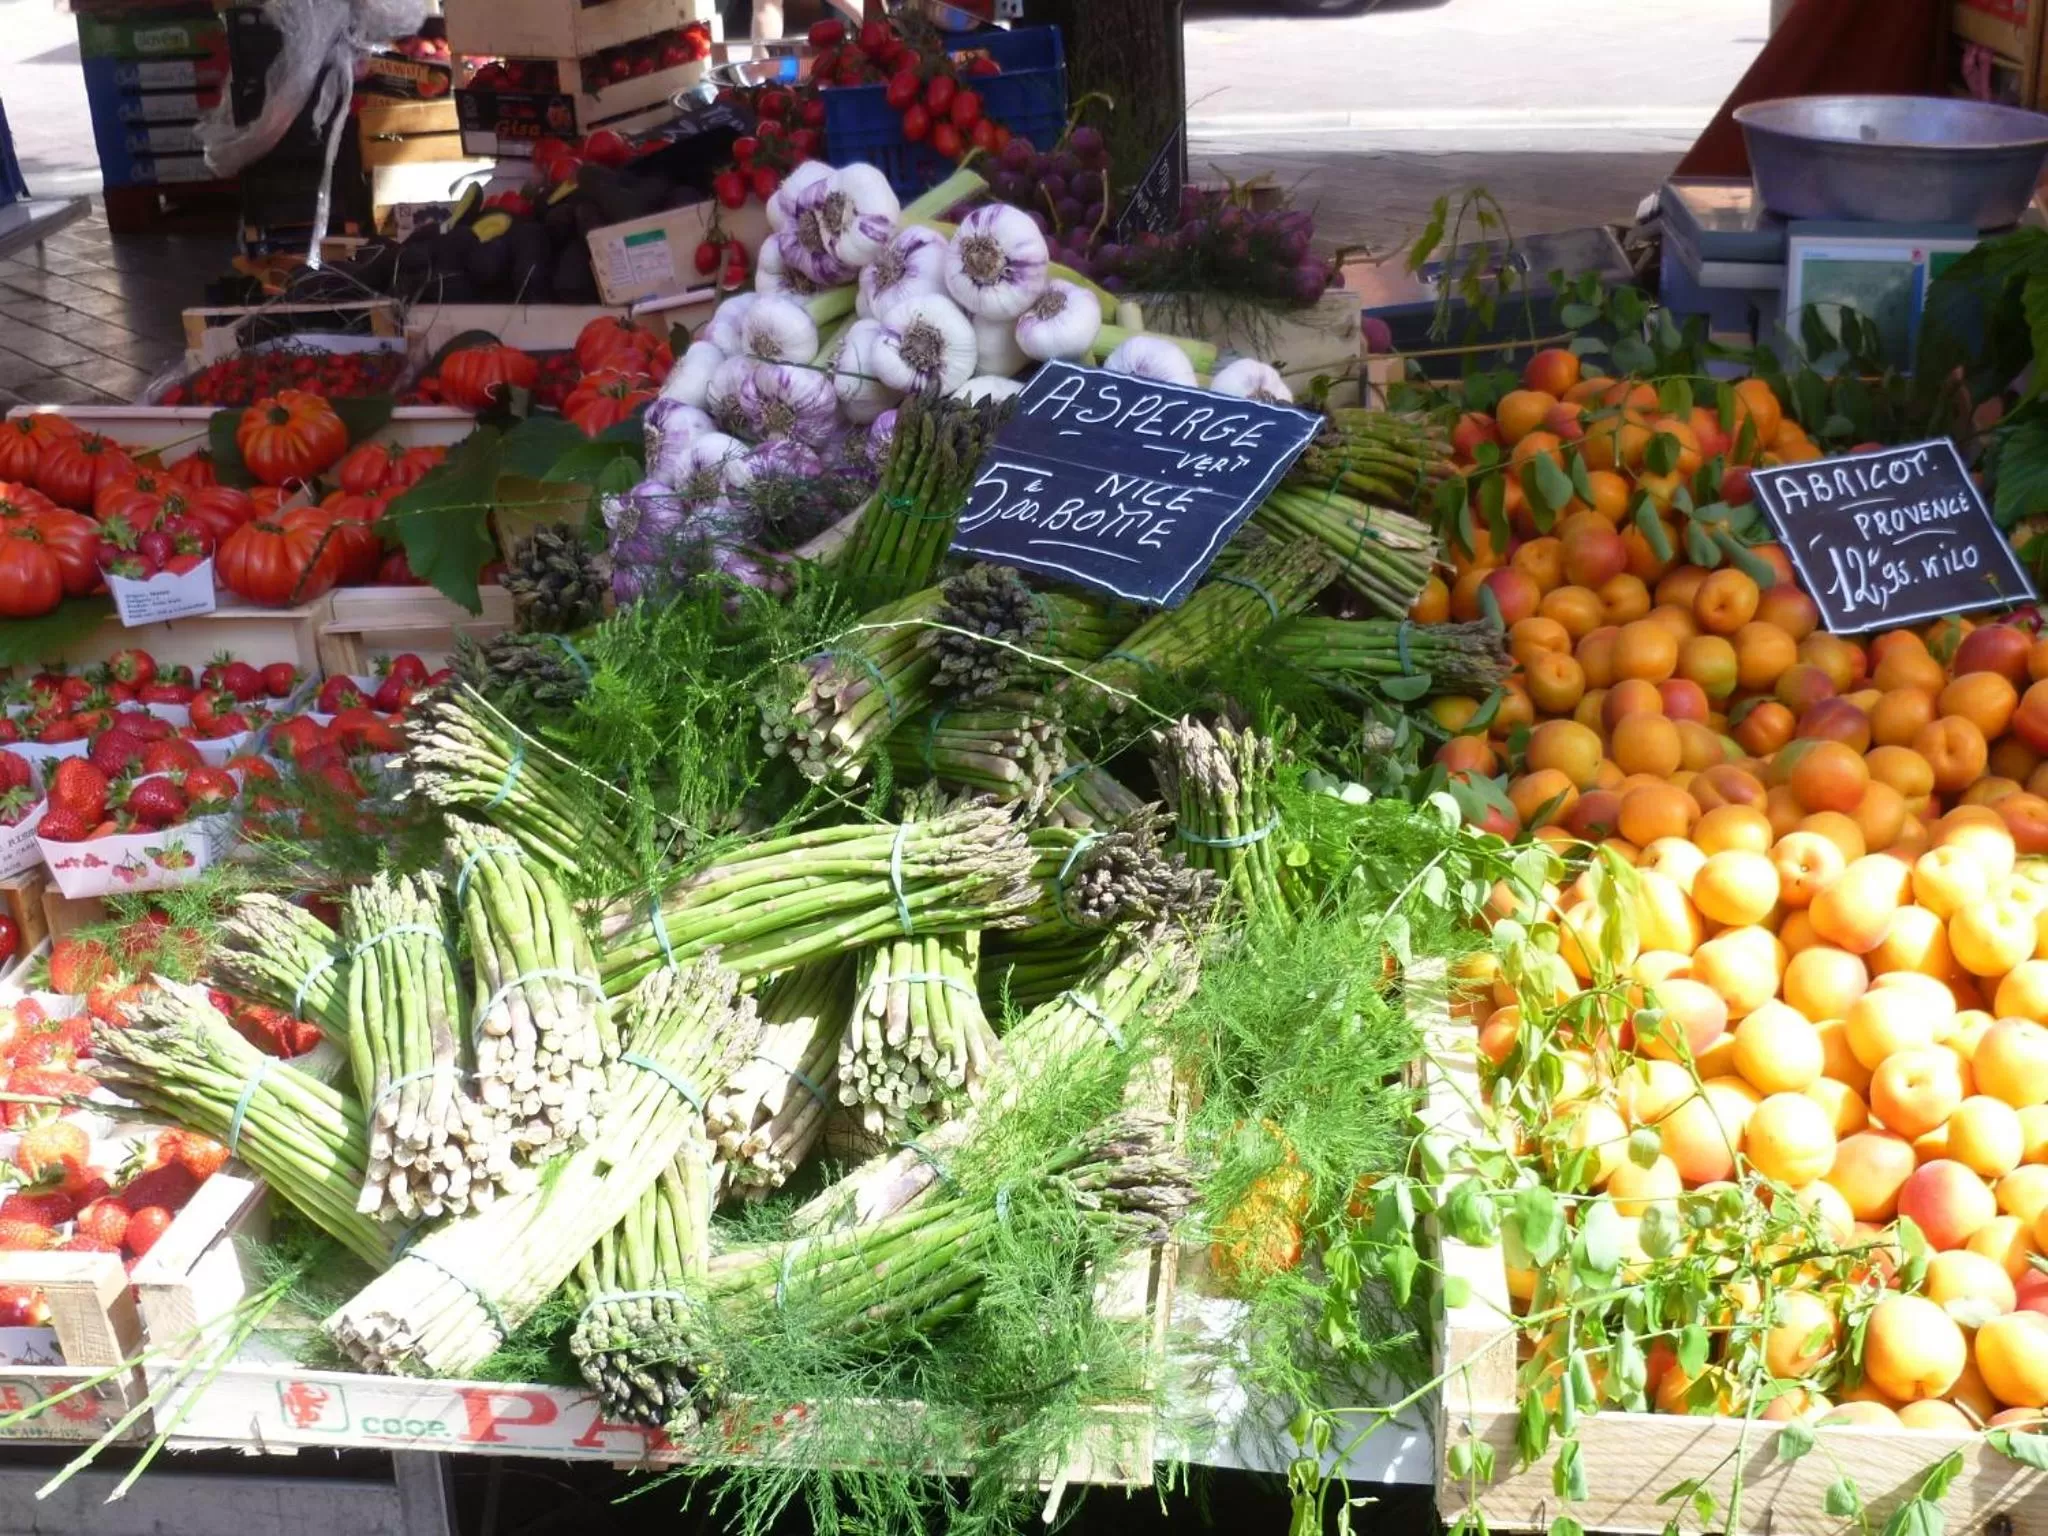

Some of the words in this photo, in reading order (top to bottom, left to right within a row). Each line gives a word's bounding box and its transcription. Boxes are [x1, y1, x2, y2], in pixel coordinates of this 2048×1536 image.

[1028, 375, 1277, 448] ASPERGE
[1095, 473, 1213, 512] NICE
[1853, 491, 1971, 541] PROVENCE
[1038, 497, 1177, 549] BOTTE
